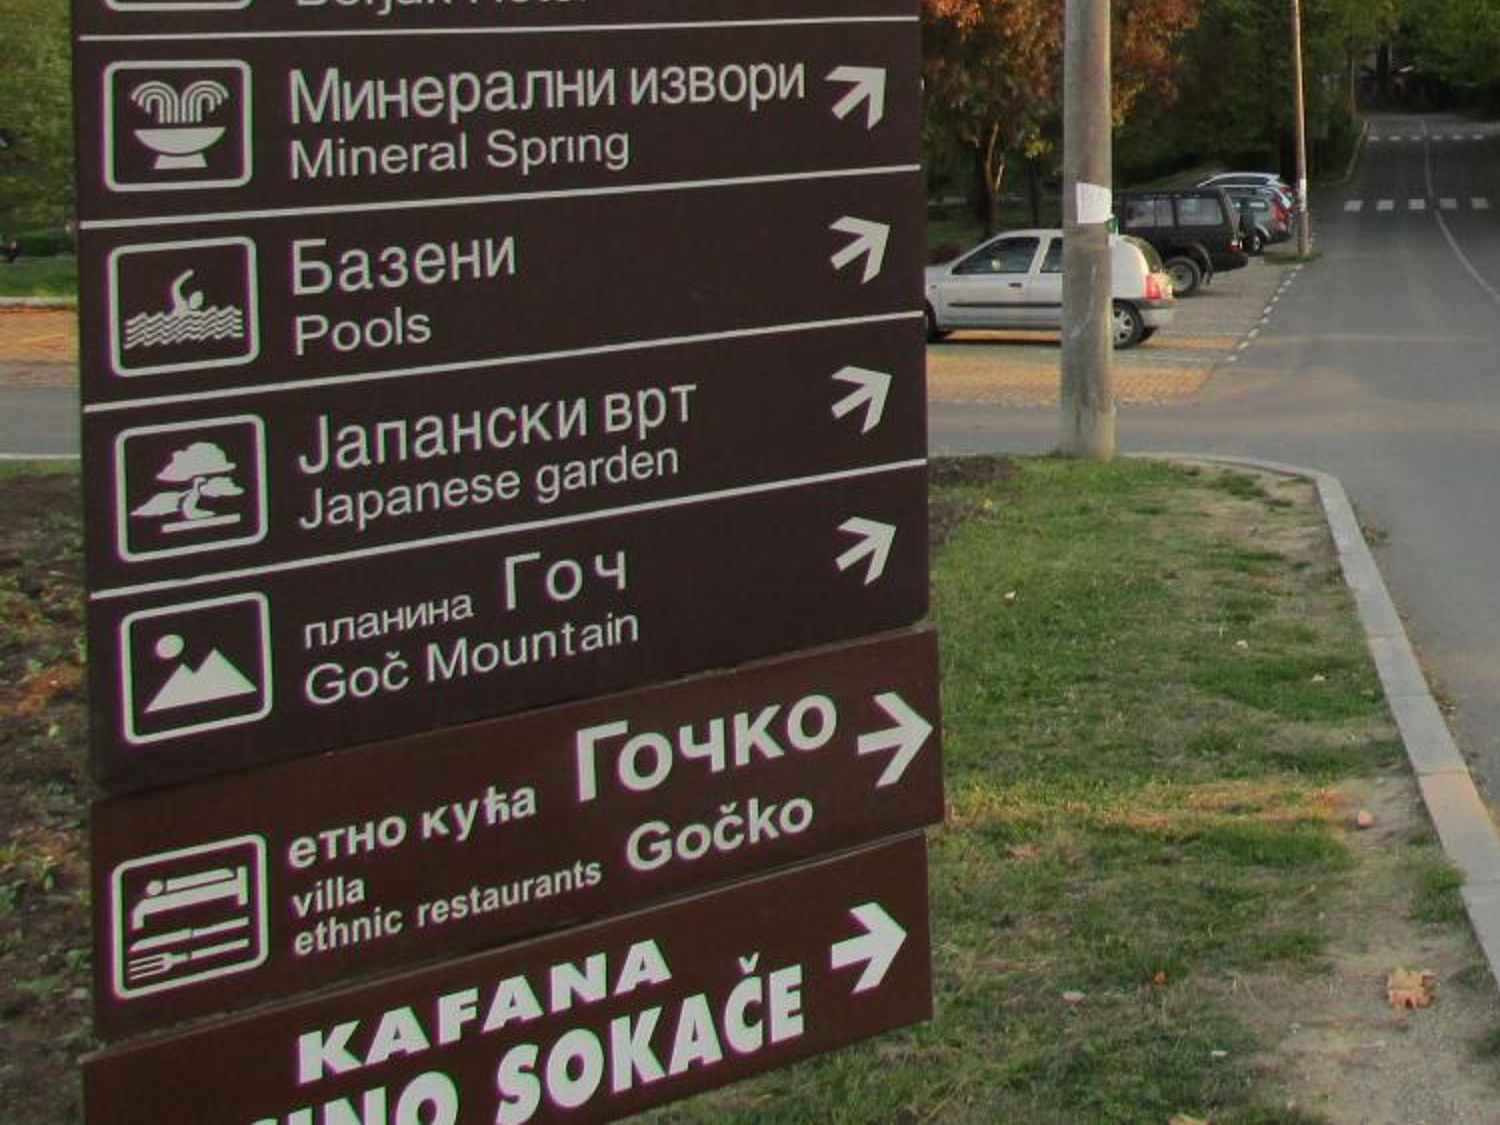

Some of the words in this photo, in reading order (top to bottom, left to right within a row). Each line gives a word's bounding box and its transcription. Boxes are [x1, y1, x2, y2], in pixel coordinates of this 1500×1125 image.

[288, 67, 616, 125] Минерални
[630, 62, 804, 112] извори
[290, 132, 467, 180] Mineral
[486, 129, 629, 175] Spring
[291, 236, 515, 295] Базени
[294, 307, 431, 356] Pools
[298, 397, 587, 474] Јапански
[604, 383, 697, 440] врт
[299, 470, 520, 531] Japanese
[535, 445, 678, 504] garden
[304, 595, 474, 649] планина
[504, 551, 626, 611] Гоч
[304, 651, 409, 706] Goč
[427, 612, 638, 683] Mountain
[288, 816, 407, 869] етно
[420, 786, 536, 842] кућа
[576, 695, 837, 803] Гочко
[625, 797, 813, 871] Gočko
[291, 876, 364, 918] villa
[293, 906, 403, 956] ethnic
[417, 860, 602, 928] restaurants
[297, 939, 672, 1084] KAFANA
[494, 952, 806, 1125] SOKAČE
